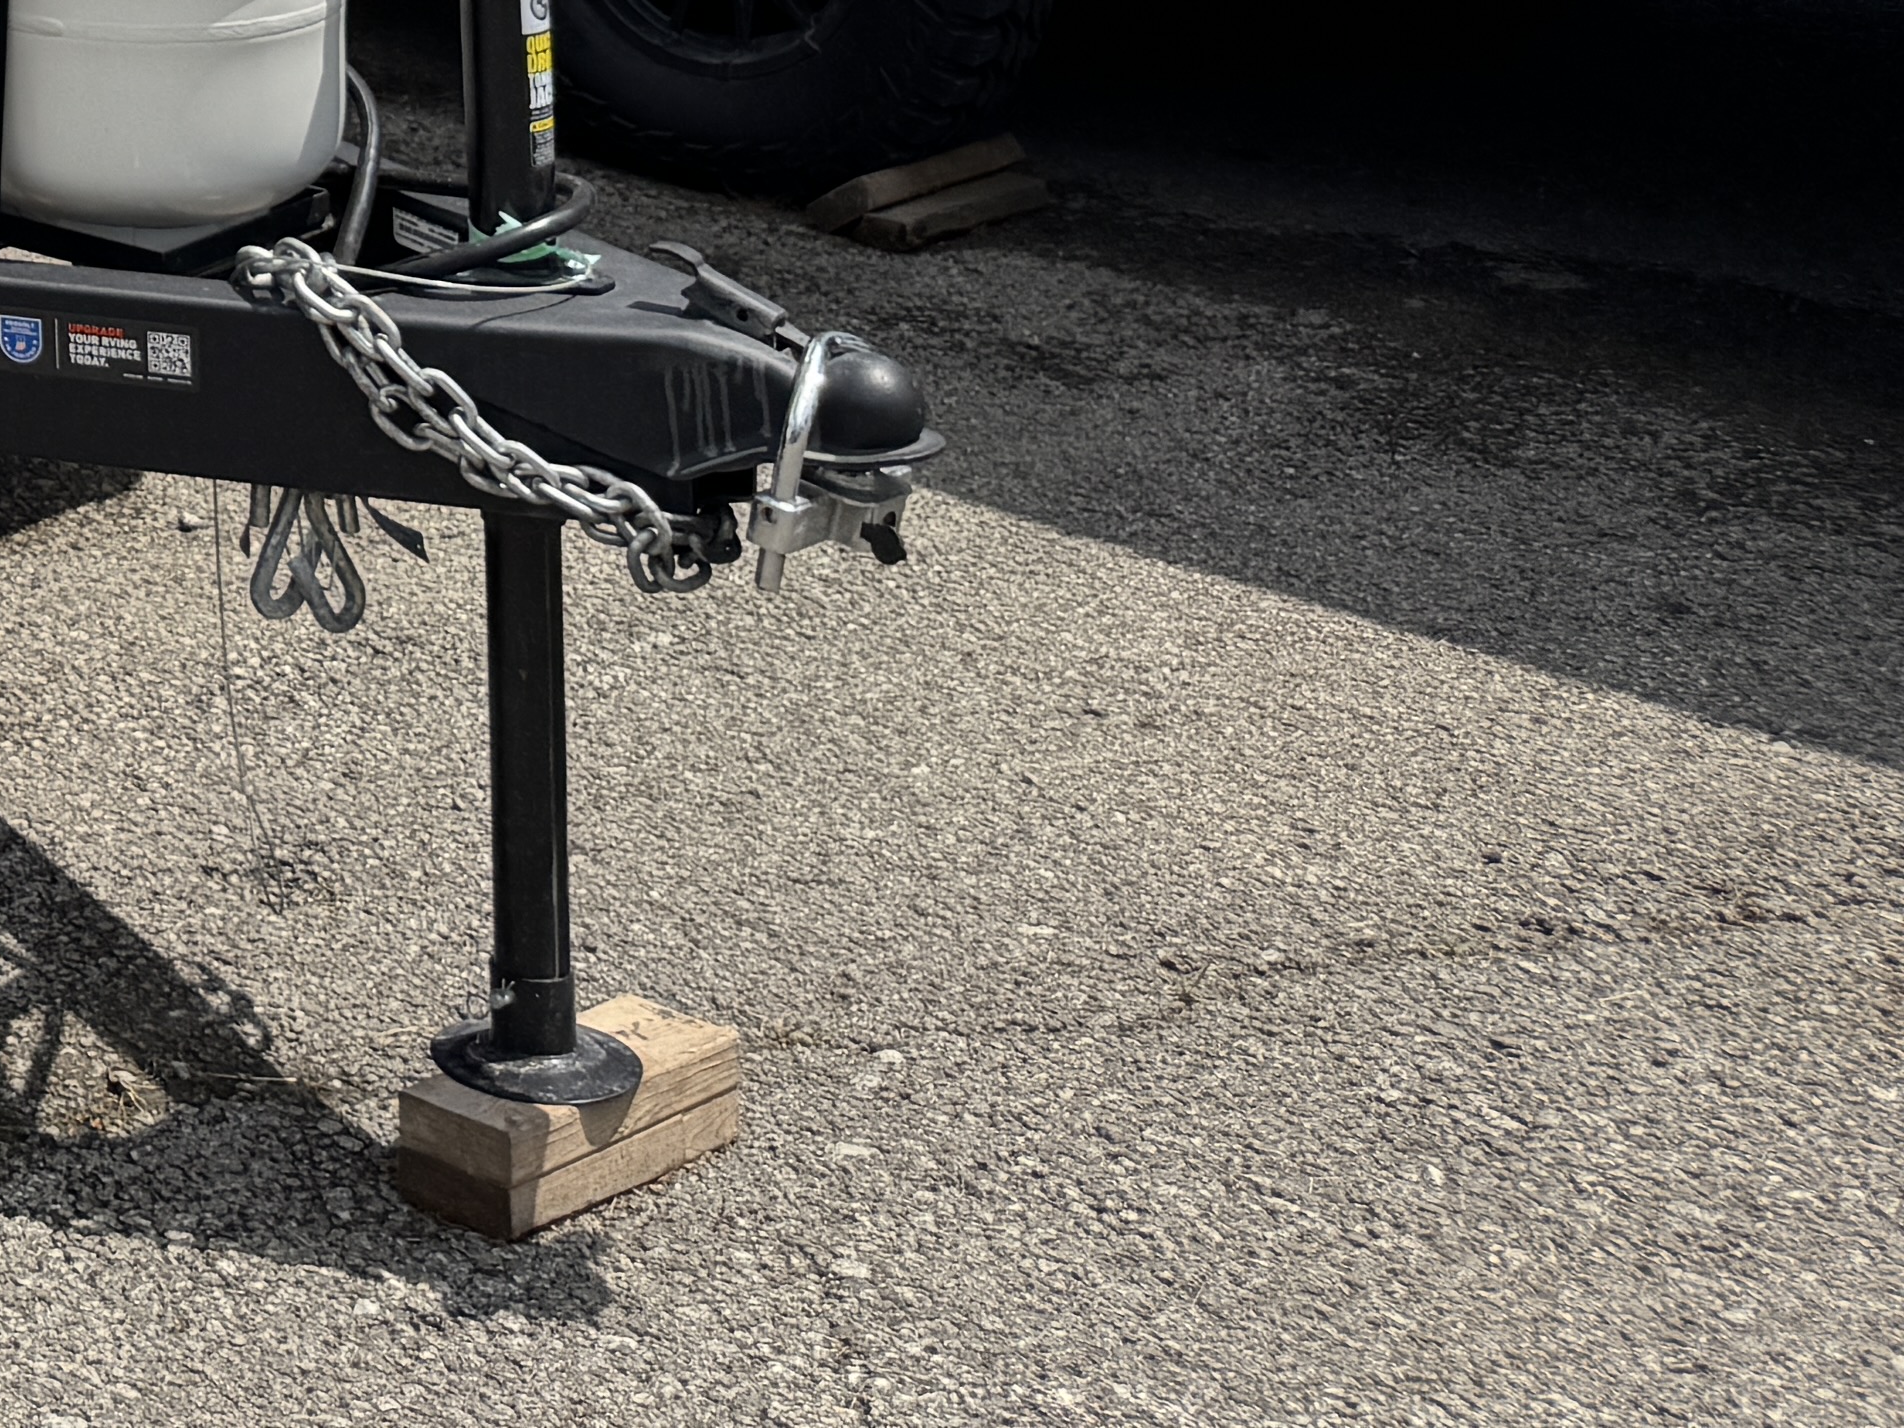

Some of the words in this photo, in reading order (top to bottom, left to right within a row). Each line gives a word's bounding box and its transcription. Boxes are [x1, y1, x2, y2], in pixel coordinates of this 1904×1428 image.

[68, 333, 100, 347] YOUR
[101, 336, 137, 350] RVING
[68, 343, 142, 361] EXPERIENCE
